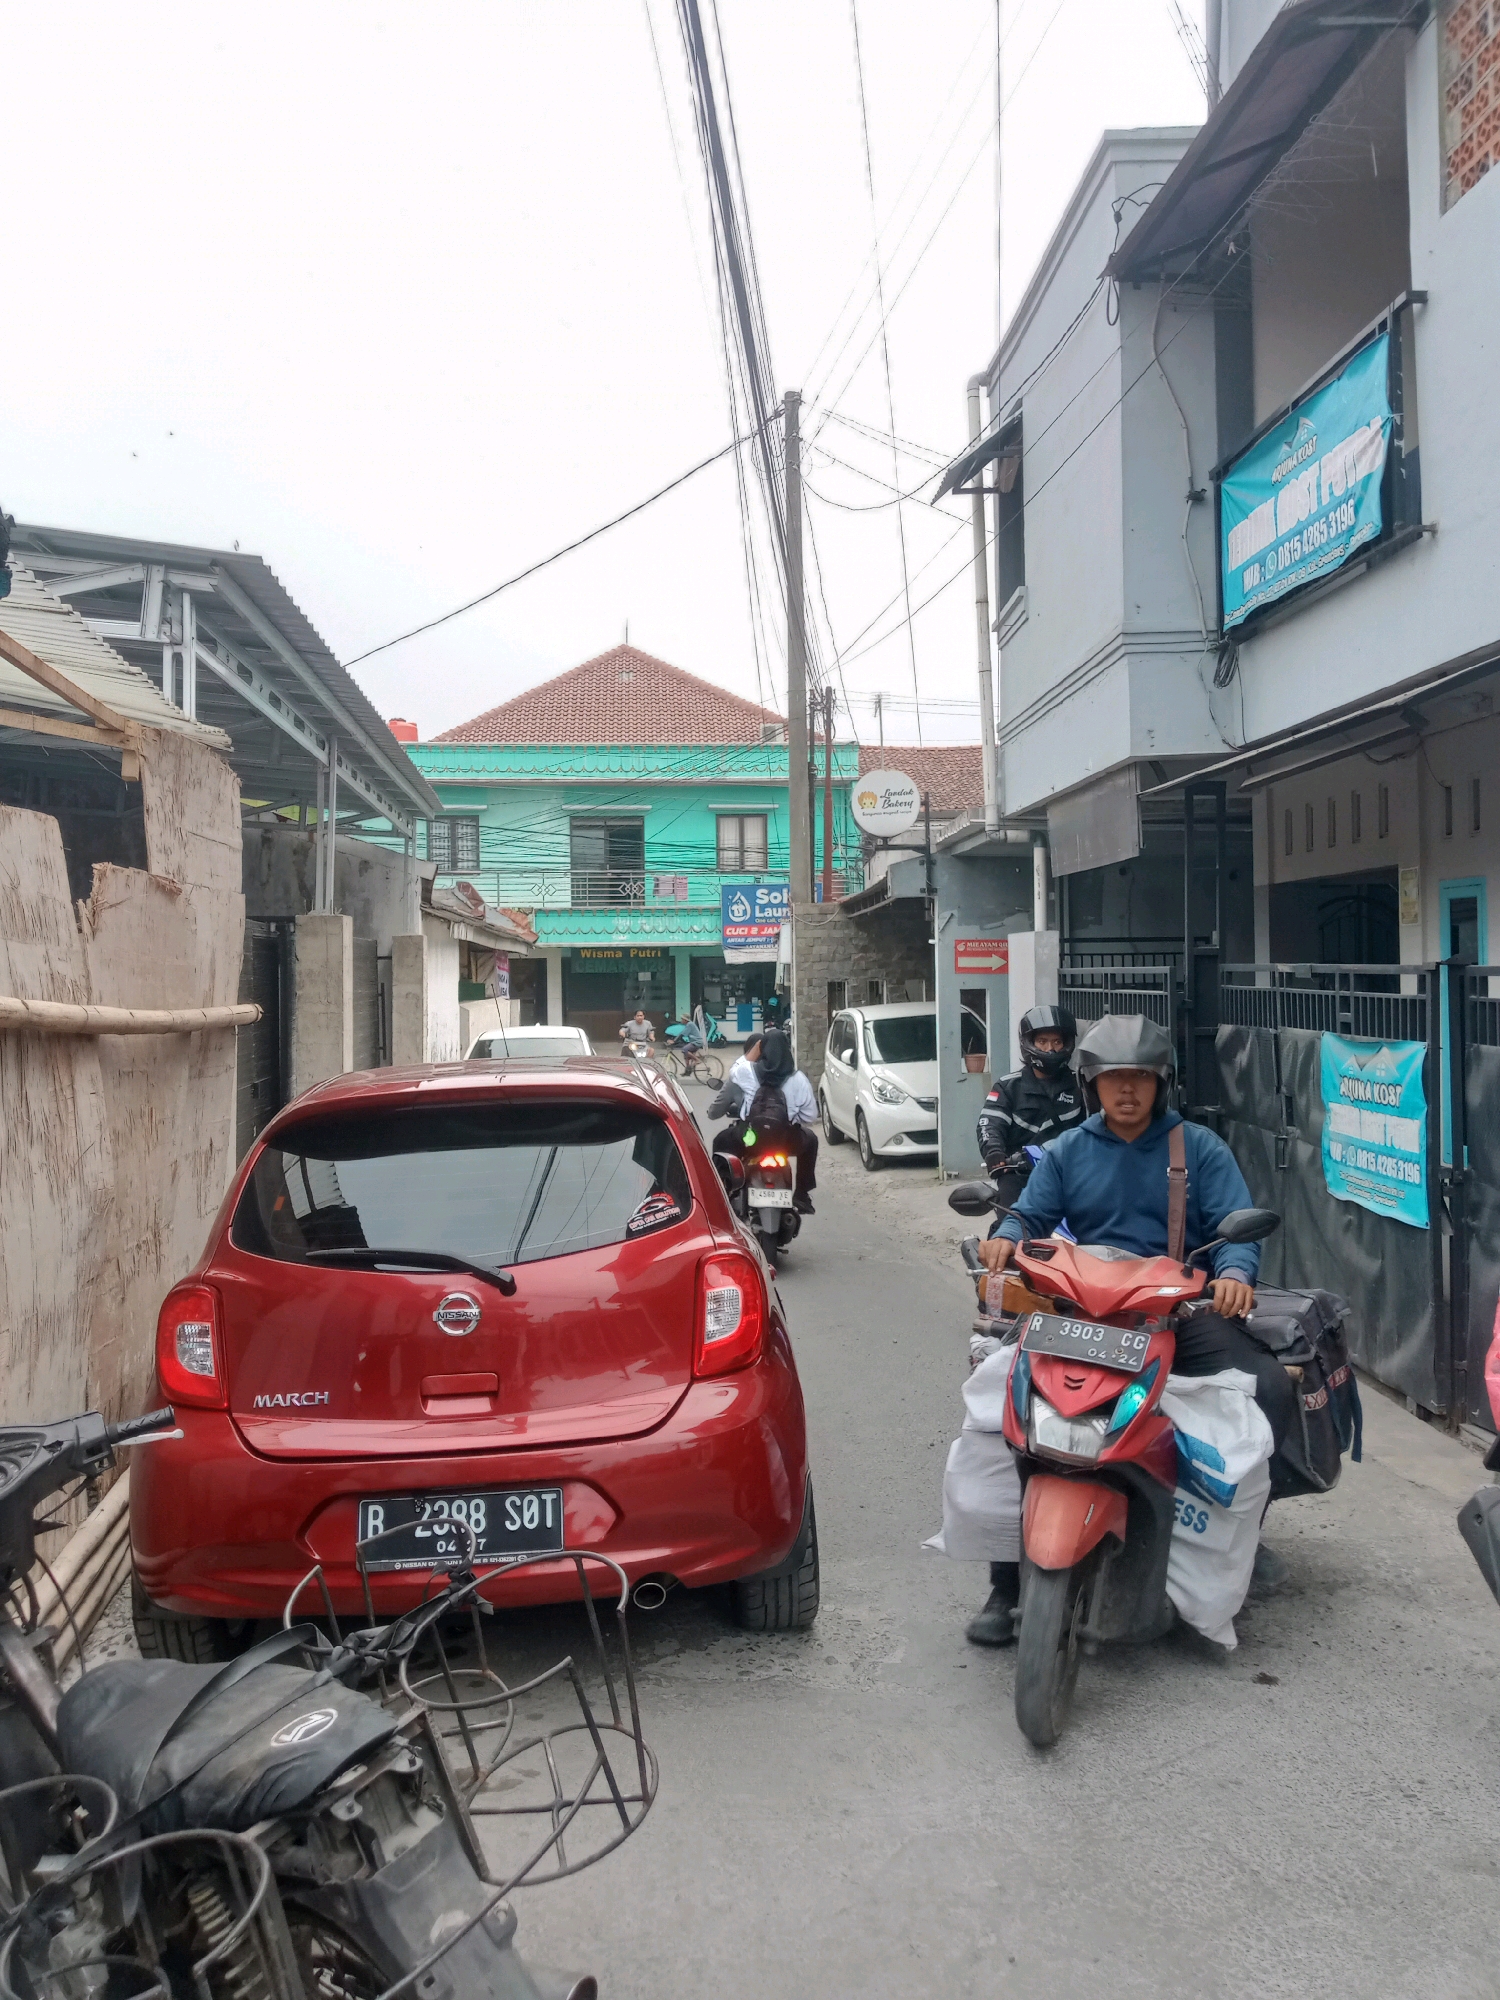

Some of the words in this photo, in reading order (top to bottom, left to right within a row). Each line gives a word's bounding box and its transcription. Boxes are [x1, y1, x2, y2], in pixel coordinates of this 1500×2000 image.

[1298, 434, 1318, 465] KOST
[1278, 536, 1301, 571] 0815
[1302, 517, 1328, 555] 4285
[1328, 499, 1355, 540] 3196
[880, 788, 914, 799] Landak
[882, 800, 914, 809] Bakery
[755, 905, 791, 918] Laun
[726, 927, 748, 936] CUCI
[580, 948, 622, 958] Wisma
[630, 948, 661, 957] Putri
[1373, 1082, 1402, 1108] KOST
[1357, 1148, 1376, 1171] 0815
[1376, 1154, 1398, 1178] 4285
[1398, 1160, 1421, 1184] 3196
[438, 1311, 478, 1319] NISSAN
[1030, 1316, 1043, 1331] R
[1059, 1321, 1105, 1342] 3903
[1121, 1332, 1146, 1350] CG
[253, 1391, 329, 1409] MARCH
[367, 1504, 384, 1538] B
